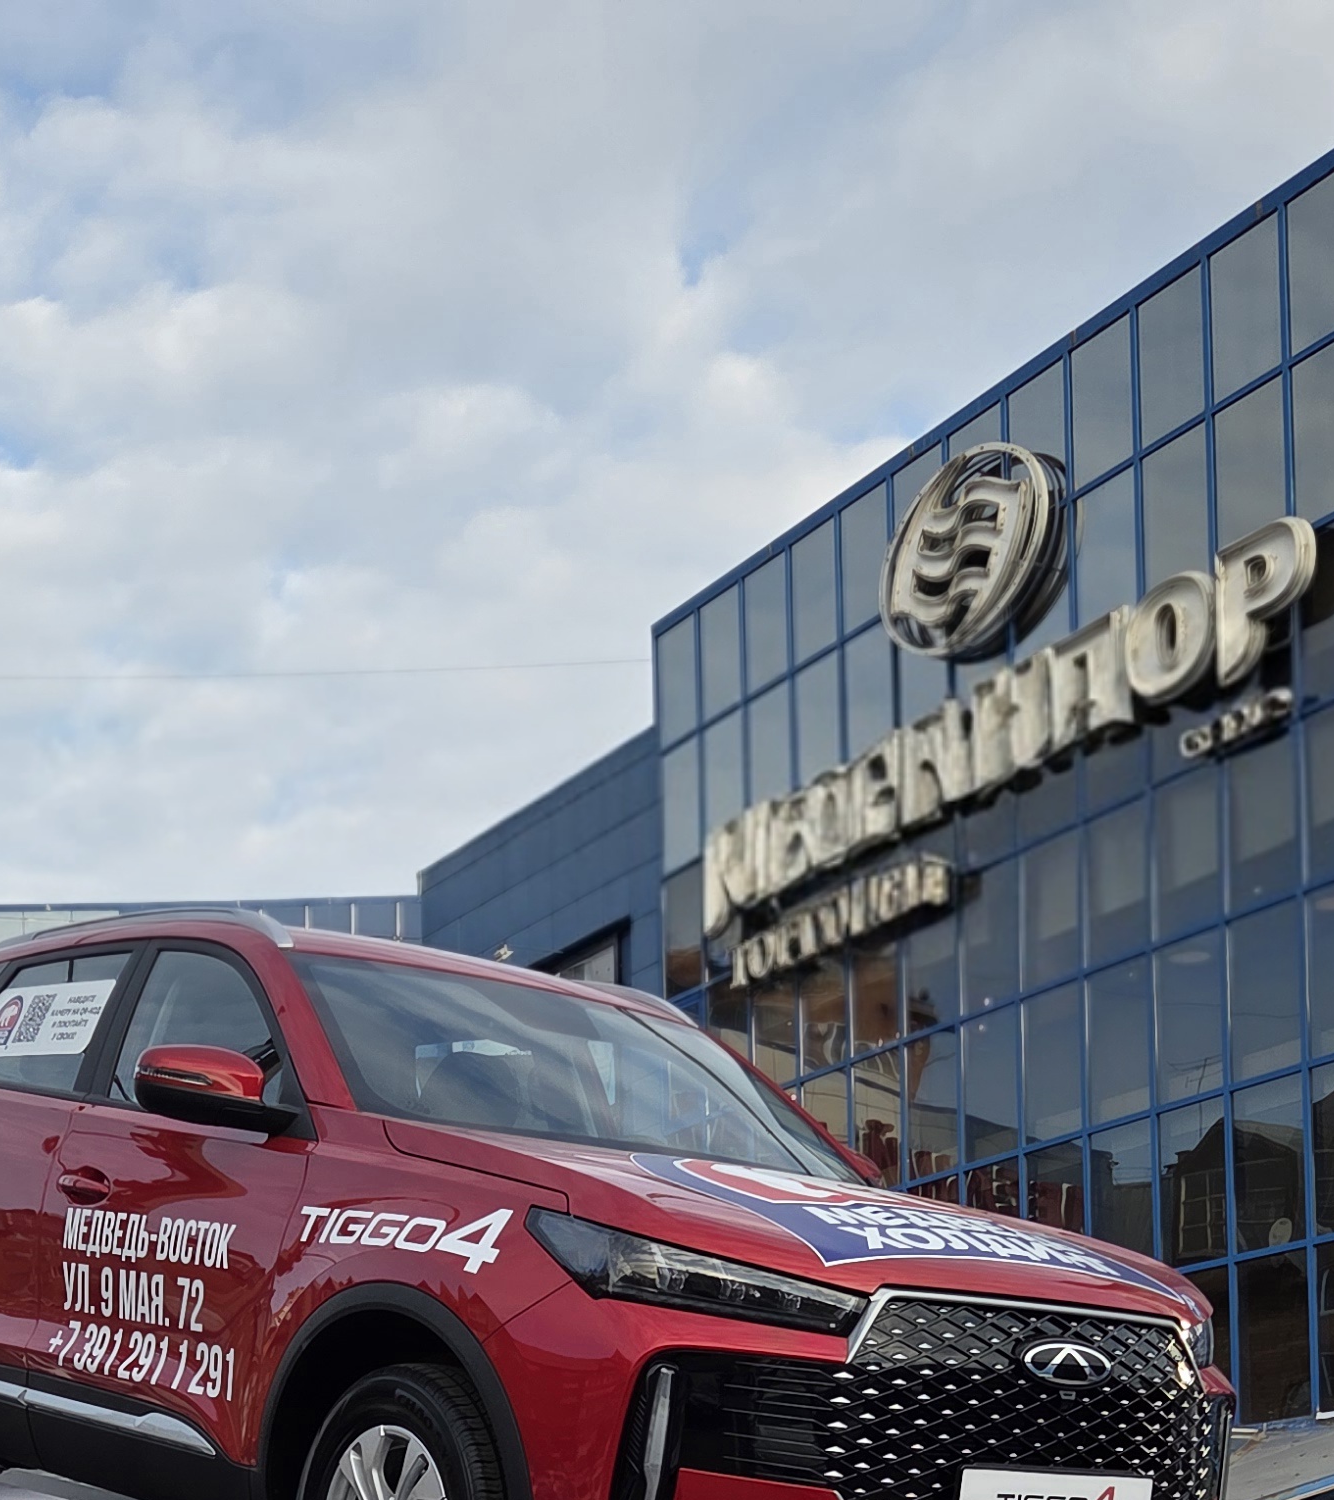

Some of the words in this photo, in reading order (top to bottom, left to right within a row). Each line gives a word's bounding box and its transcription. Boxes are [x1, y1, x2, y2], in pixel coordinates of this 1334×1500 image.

[63, 1207, 236, 1269] МЕДВЕДЬ-ВОСТОК
[63, 1262, 95, 1314] УЛ.
[101, 1267, 113, 1317] 9
[119, 1269, 169, 1327] МАЯ.
[177, 1277, 204, 1332] 72
